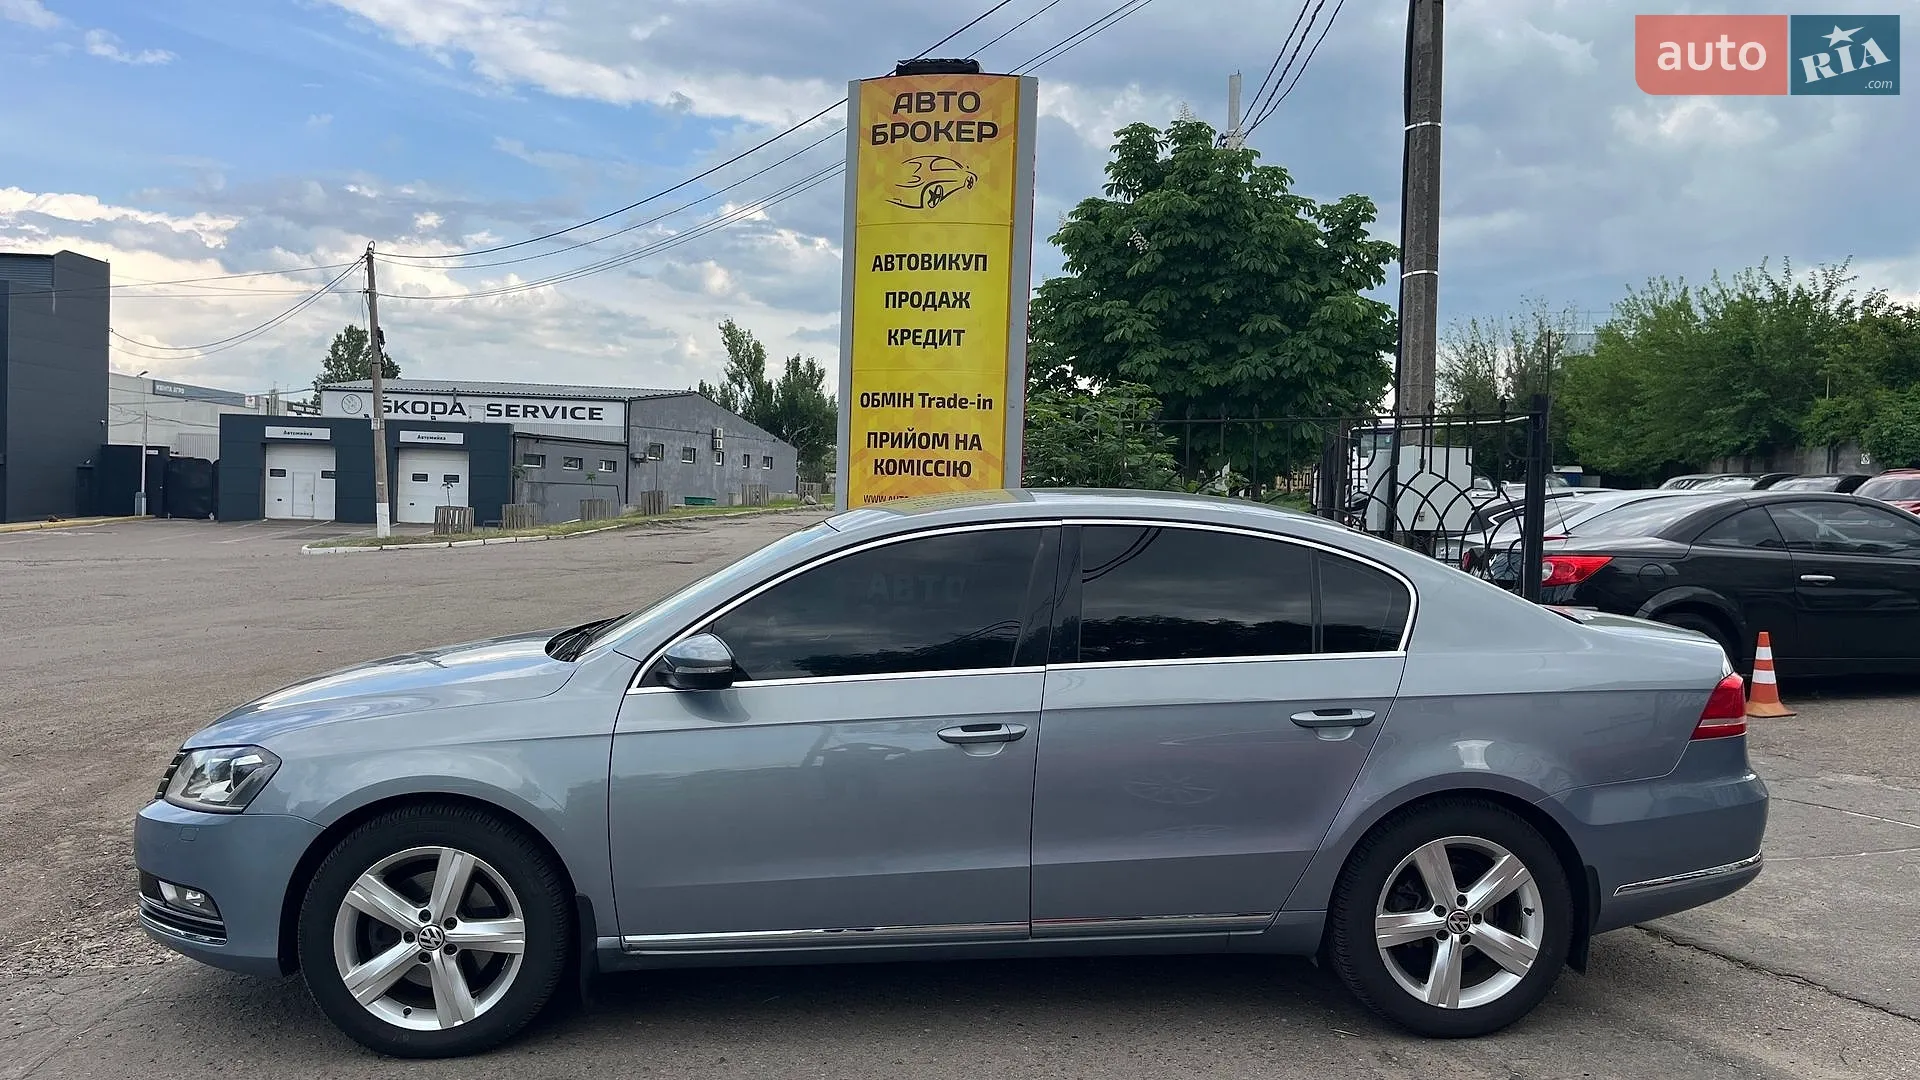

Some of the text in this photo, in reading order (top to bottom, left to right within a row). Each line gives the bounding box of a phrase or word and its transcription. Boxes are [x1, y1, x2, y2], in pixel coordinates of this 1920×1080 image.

[892, 91, 981, 115] АВТО
[871, 120, 999, 146] БРОКЕР
[871, 253, 988, 273] АВТОВИКУП
[884, 291, 971, 312] ПРОДАЖ
[887, 328, 966, 350] КРЕДИТ
[860, 392, 993, 410] ОБМІН Trade-in
[486, 403, 604, 421] SERVICE
[866, 427, 982, 451] ПРИЙОМ НА
[873, 458, 972, 478] КОМІССІЮ
